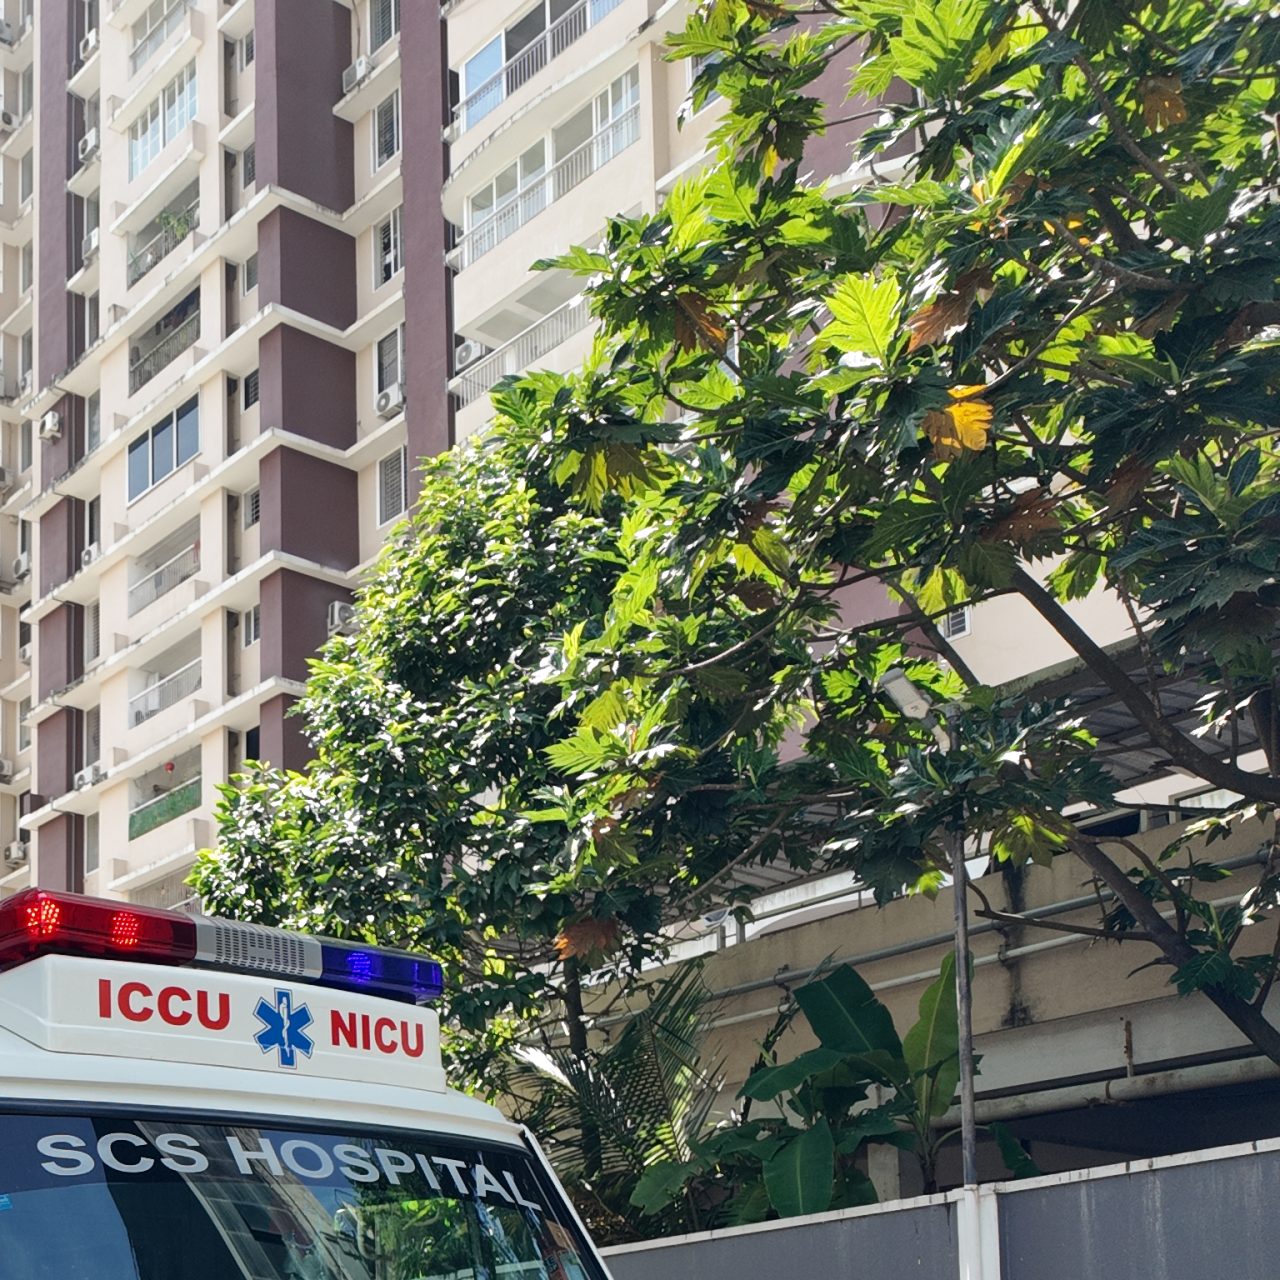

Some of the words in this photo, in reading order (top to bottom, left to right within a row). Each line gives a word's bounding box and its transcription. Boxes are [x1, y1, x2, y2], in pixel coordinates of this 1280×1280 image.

[98, 978, 231, 1031] ICCU
[330, 1009, 424, 1059] NICU
[37, 1132, 208, 1177] SCS
[225, 1133, 541, 1211] HOSPITAL
